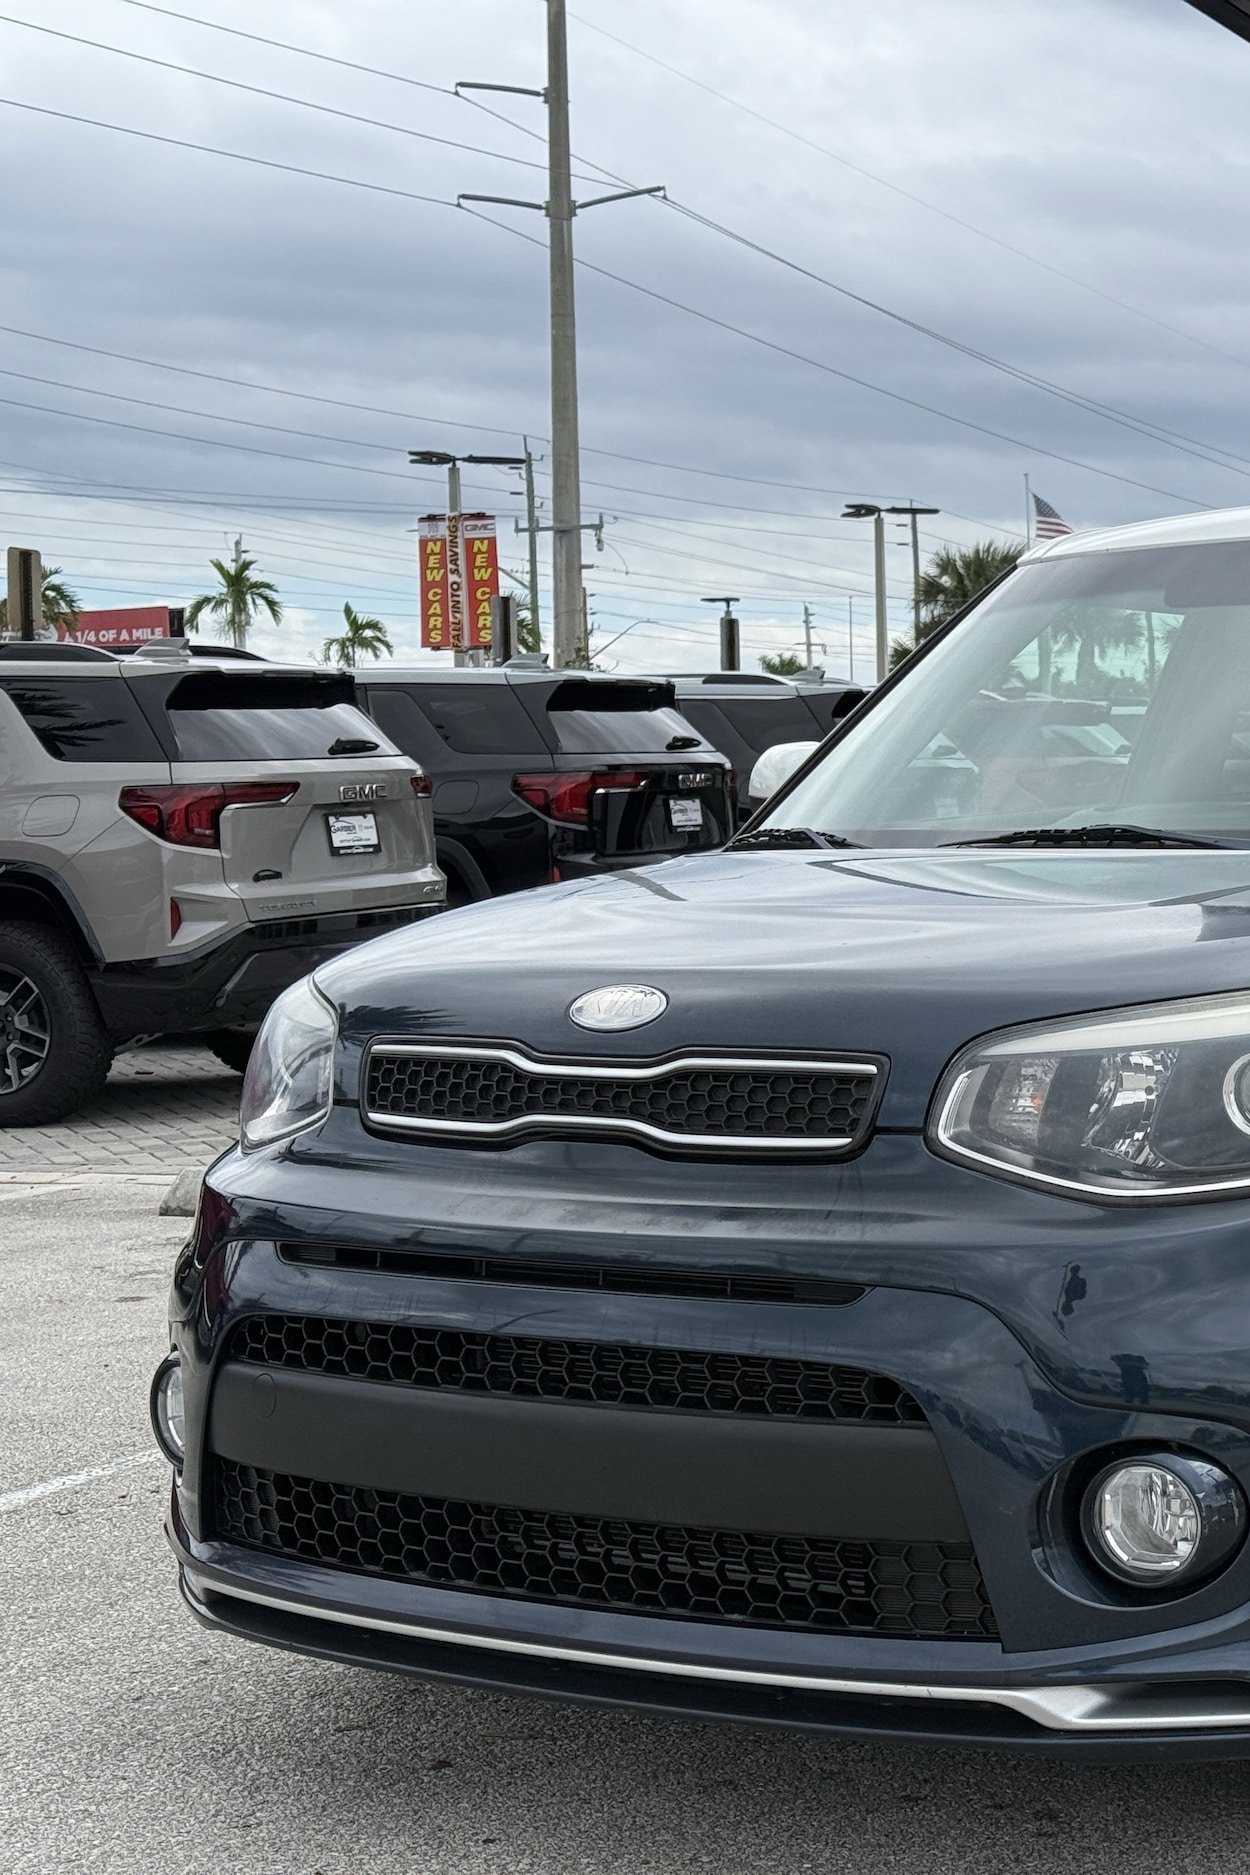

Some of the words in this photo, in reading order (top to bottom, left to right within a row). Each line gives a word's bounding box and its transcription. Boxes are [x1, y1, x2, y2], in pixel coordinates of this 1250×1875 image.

[464, 522, 496, 532] GMC
[425, 541, 445, 581] NEW
[447, 515, 460, 575] SAVINGS
[472, 539, 493, 580] NEW
[450, 581, 461, 615] INTO
[475, 587, 492, 643] CARS
[427, 588, 443, 643] CARS
[76, 629, 97, 643] 1/4
[100, 629, 118, 643] OF
[119, 628, 130, 642] A
[132, 626, 164, 641] MILE
[452, 619, 462, 649] FALL
[340, 784, 388, 801] GMC
[678, 773, 713, 789] GMC
